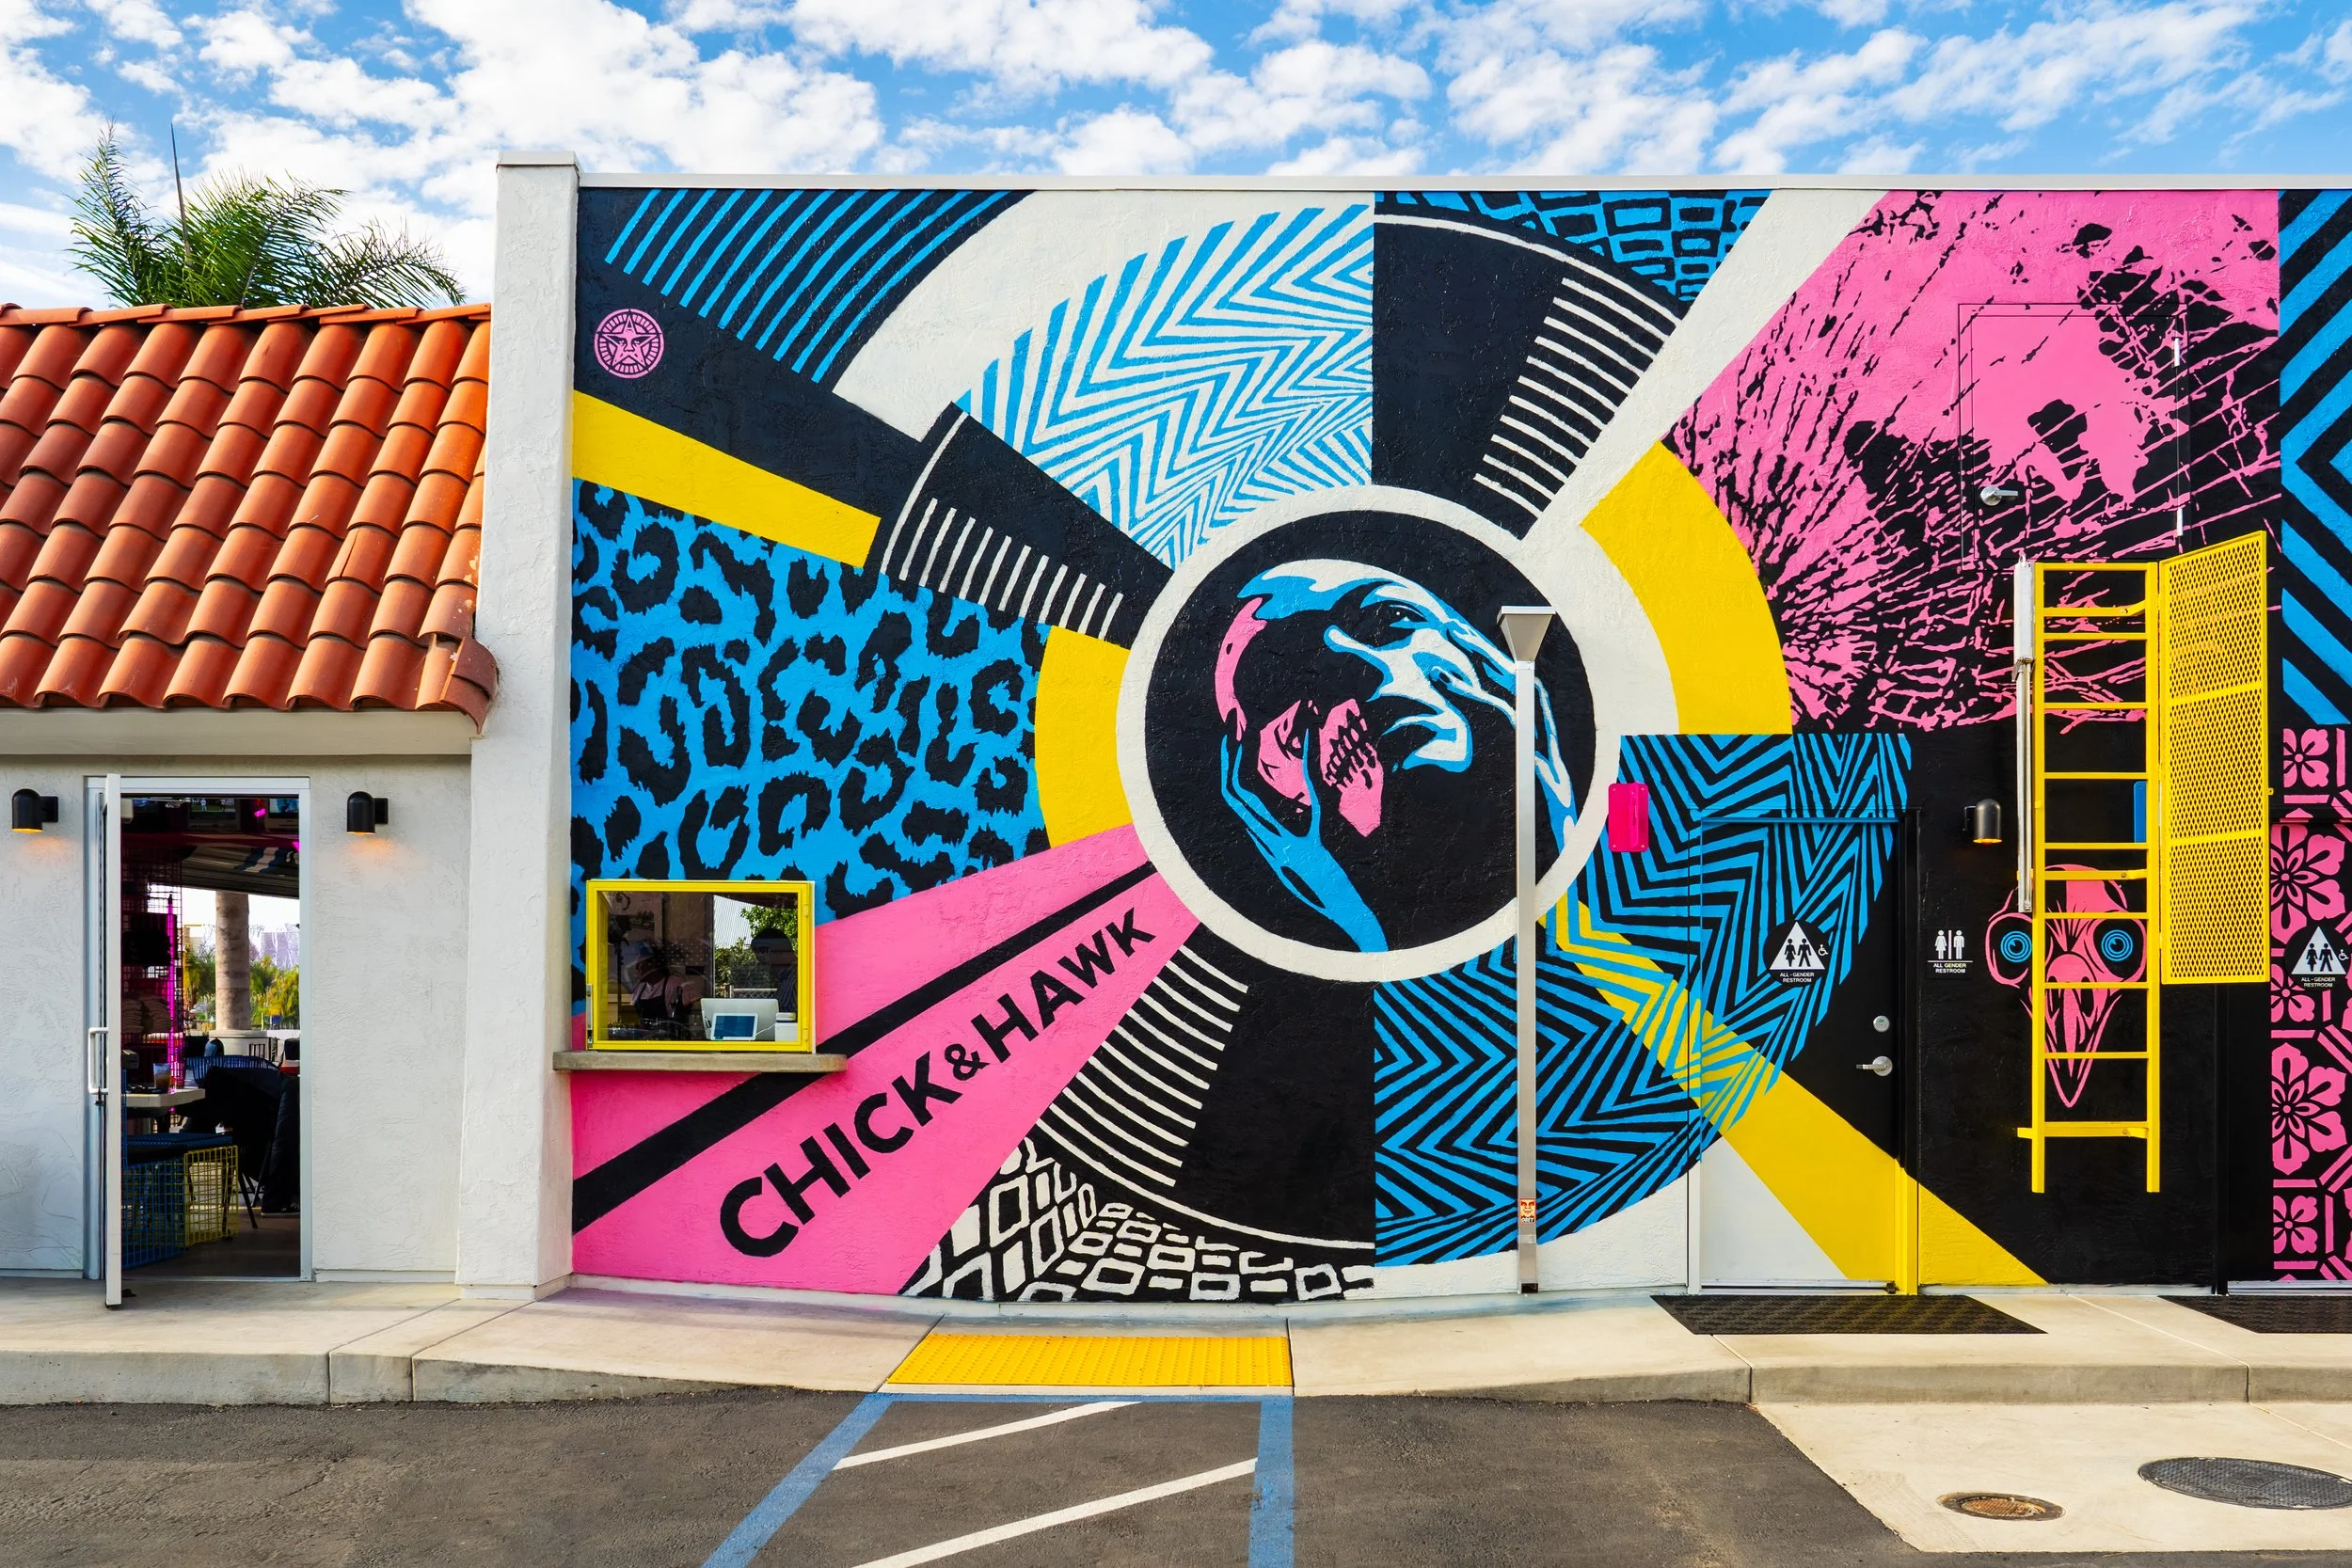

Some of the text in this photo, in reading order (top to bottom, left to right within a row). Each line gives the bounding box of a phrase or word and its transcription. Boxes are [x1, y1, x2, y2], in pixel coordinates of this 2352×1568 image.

[720, 907, 1155, 1258] CHICK & HAWK
